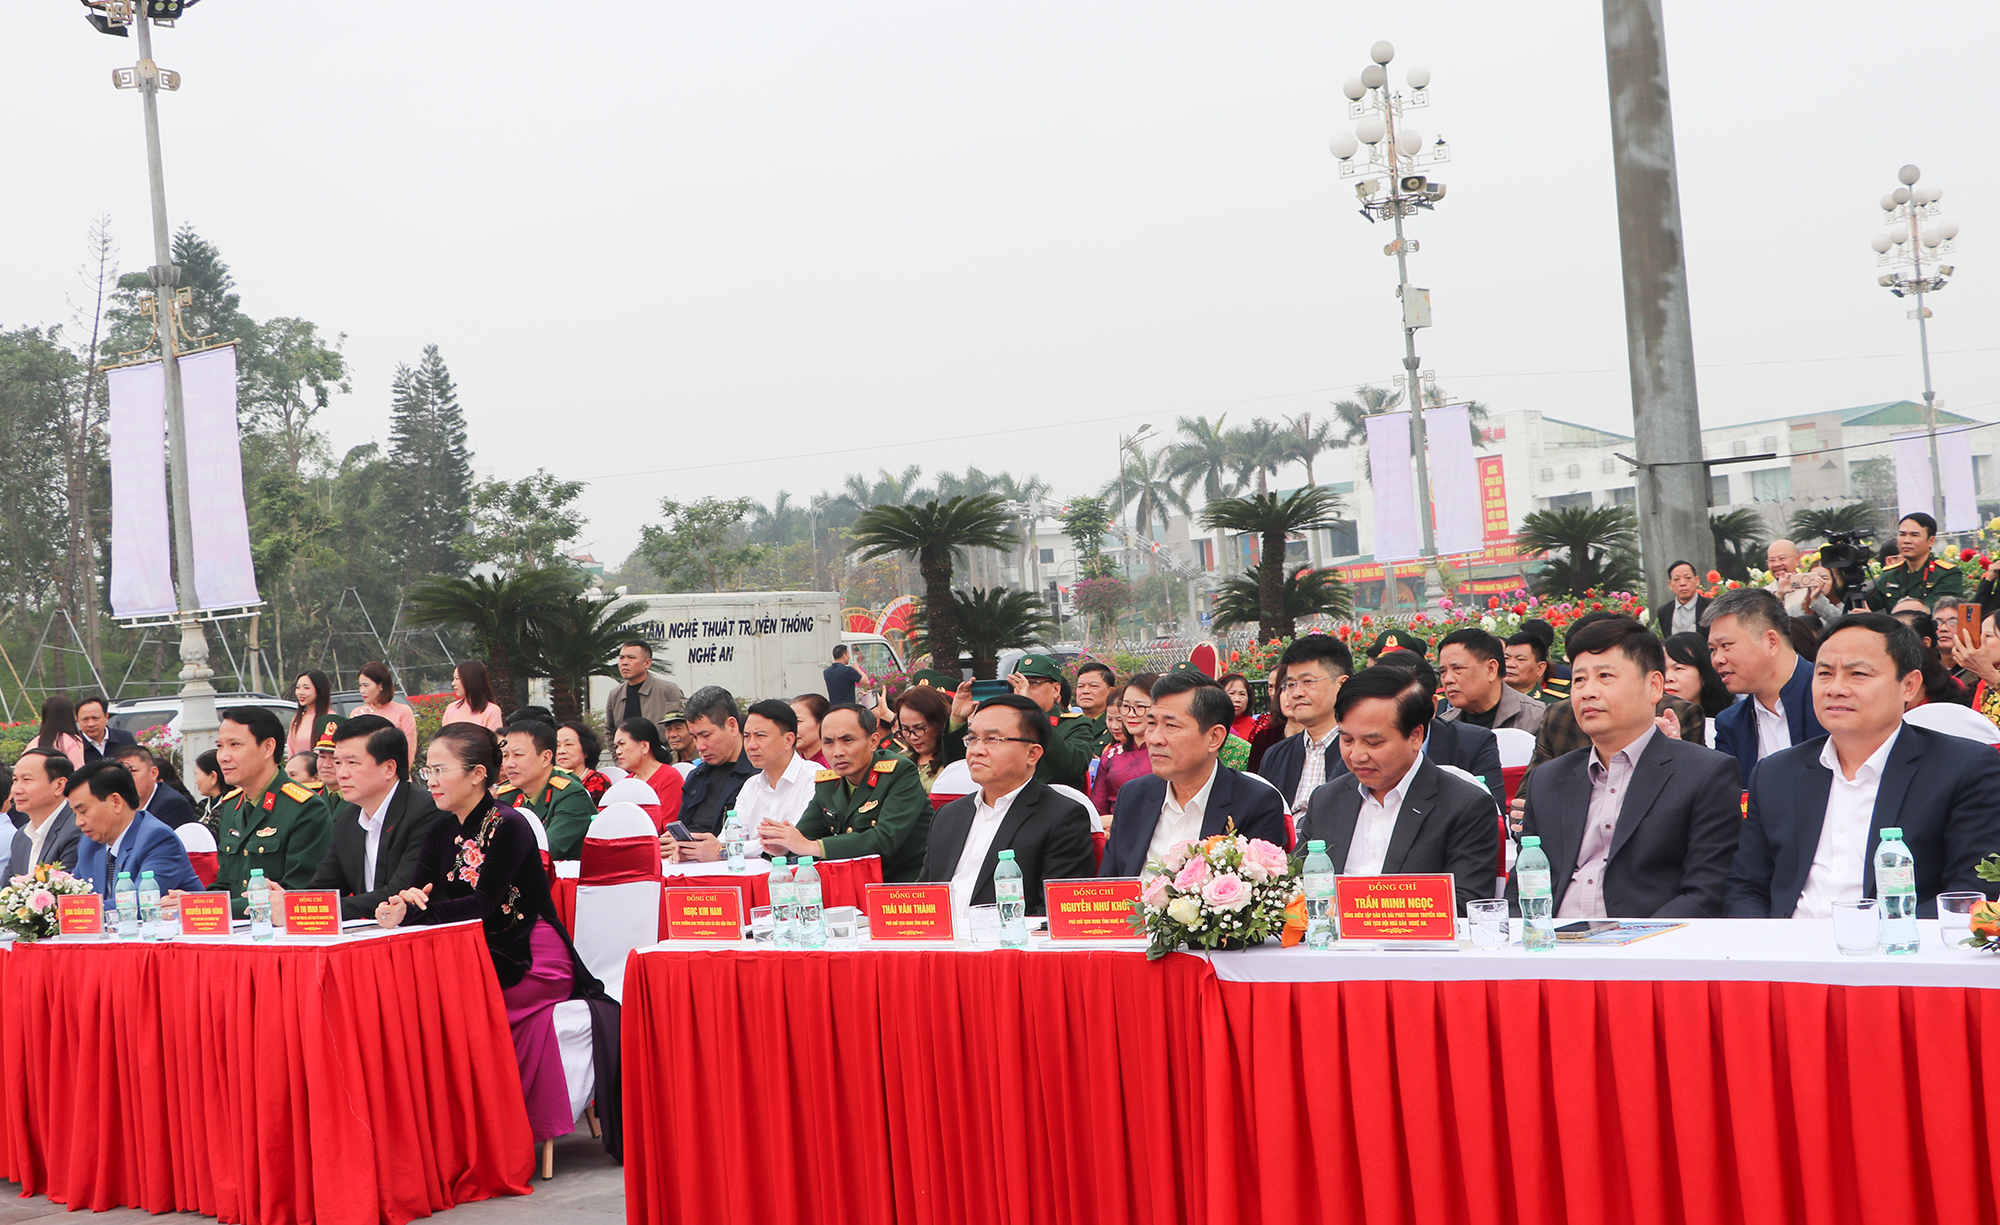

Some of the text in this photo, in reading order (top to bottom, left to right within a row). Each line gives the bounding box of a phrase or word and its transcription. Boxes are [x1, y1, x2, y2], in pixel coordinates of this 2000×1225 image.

[669, 618, 699, 642] NGHỆ
[702, 617, 735, 640] THUẬT
[739, 612, 776, 636] TRUYỀN
[781, 610, 814, 633] THỐNG
[688, 643, 734, 666] NGHỆ AN
[1073, 887, 1114, 896] ĐỒNG CHÍ
[1368, 881, 1416, 891] ĐỒNG CHÍ
[686, 894, 704, 902] ĐỒNG
[890, 890, 925, 899] ĐỒNG CHÍ
[882, 902, 936, 914] THÁI VĂN THÀNH
[1060, 899, 1091, 912] NGUYỄN
[1093, 900, 1110, 912] NHƯ
[1354, 894, 1434, 911] TRẦN MINH NGỌC
[683, 907, 722, 917] NGỌC KIM NAM
